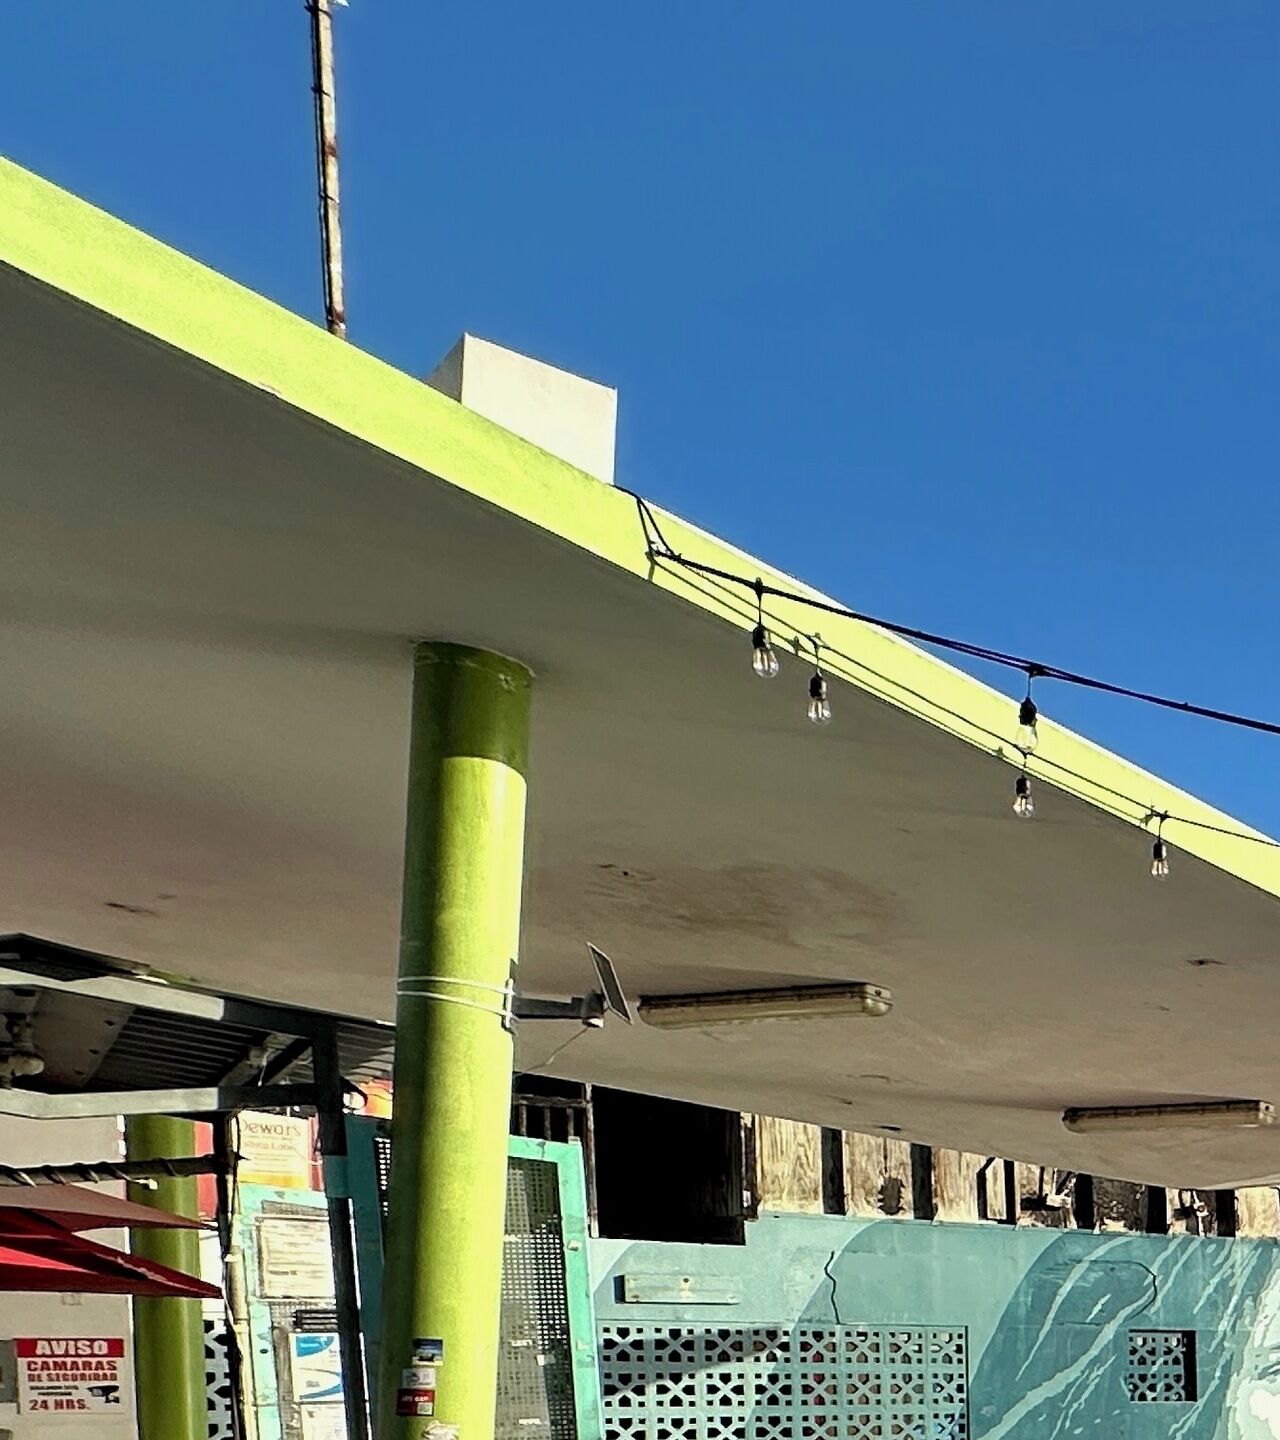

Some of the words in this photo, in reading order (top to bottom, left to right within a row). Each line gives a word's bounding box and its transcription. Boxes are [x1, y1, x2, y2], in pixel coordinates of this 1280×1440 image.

[34, 1340, 109, 1356] AVISO
[27, 1360, 118, 1372] CAMARAS
[27, 1373, 43, 1382] DE
[47, 1372, 118, 1382] SEGURIDAD
[29, 1399, 49, 1411] 24
